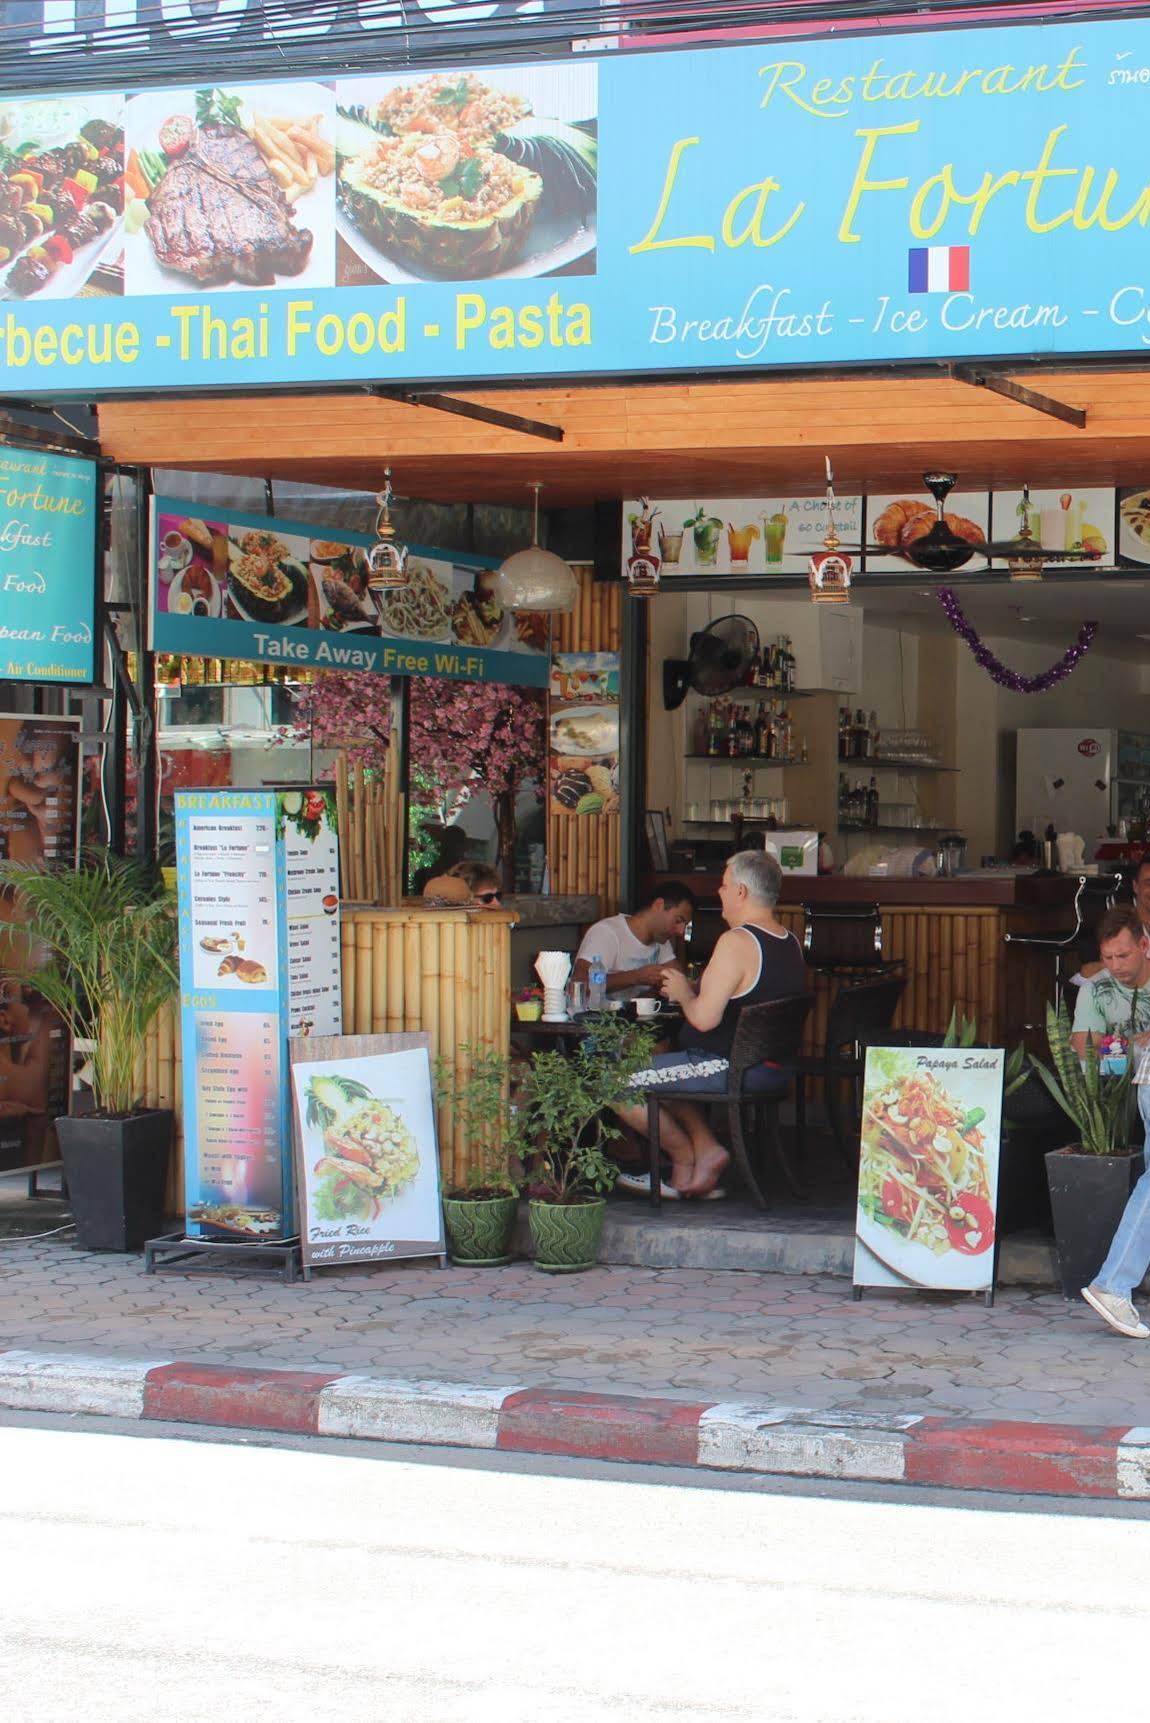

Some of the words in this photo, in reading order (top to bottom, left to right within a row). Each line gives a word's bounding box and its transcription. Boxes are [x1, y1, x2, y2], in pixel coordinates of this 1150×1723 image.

[757, 47, 1087, 118] Restaurant
[629, 136, 804, 254] La
[288, 297, 406, 356] Food
[457, 293, 592, 350] Pasta
[649, 284, 833, 359] Breakfast
[940, 293, 1067, 331] Cream
[3, 571, 46, 593] Food
[51, 622, 91, 644] Food
[253, 633, 308, 660] Take
[315, 641, 377, 672] Away
[384, 648, 428, 671] Free
[435, 654, 484, 676] Wi-Fi
[26, 662, 88, 678] Conditioner
[177, 793, 273, 810] BREAKFAST
[916, 1056, 958, 1072] Papaya
[962, 1057, 999, 1070] Salad
[310, 1226, 342, 1241] Fried
[346, 1223, 372, 1236] Rice
[311, 1244, 337, 1259] with
[338, 1241, 396, 1258] Pineapple
